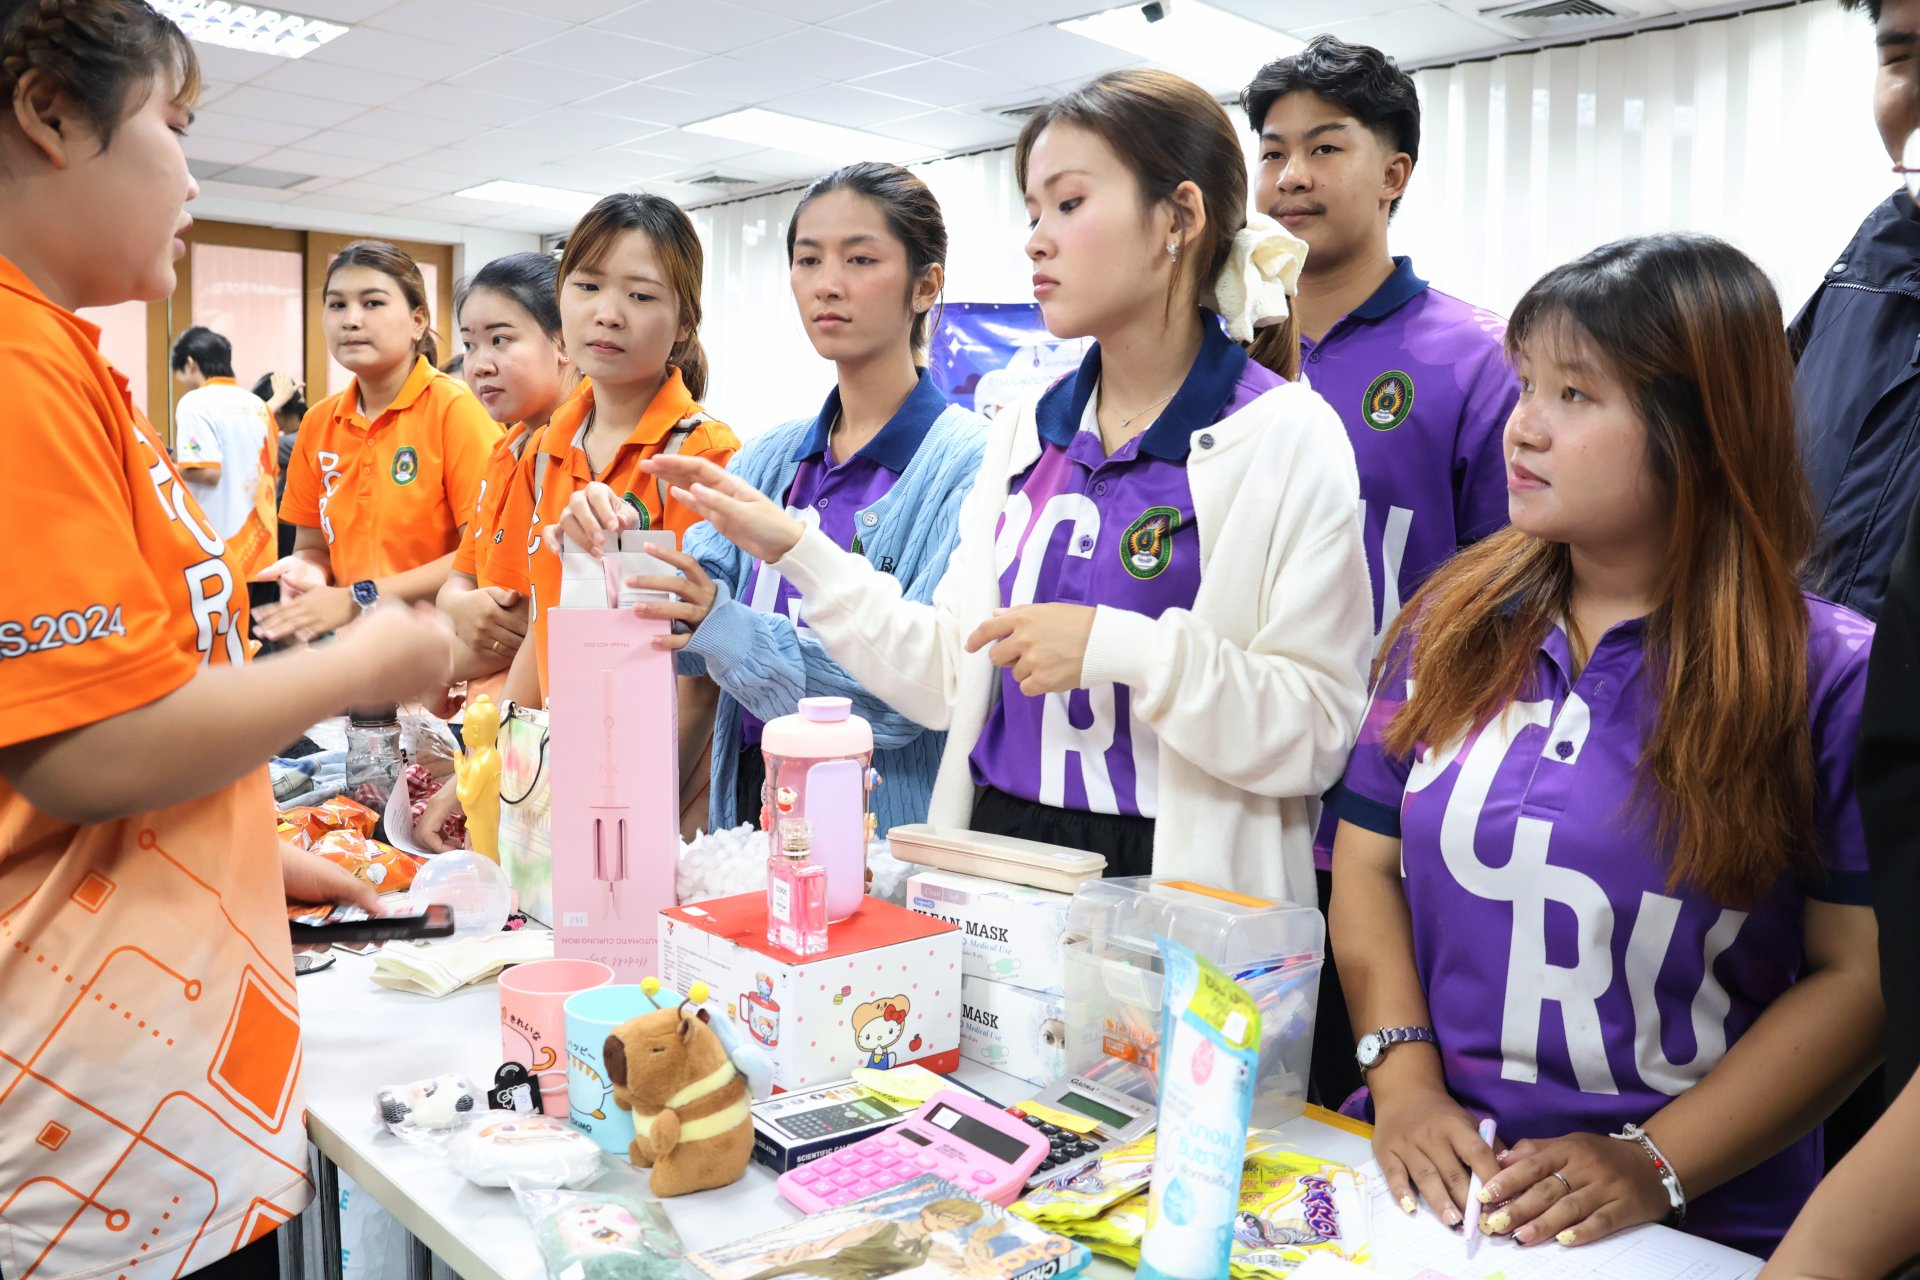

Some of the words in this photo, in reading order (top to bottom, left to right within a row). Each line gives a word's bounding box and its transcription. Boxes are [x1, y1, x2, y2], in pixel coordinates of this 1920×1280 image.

[965, 920, 1009, 943] MASK
[561, 937, 580, 945] IRON
[582, 937, 614, 945] CURLING
[970, 938, 997, 952] Medical
[962, 1003, 999, 1030] MASK
[965, 1021, 989, 1038] Medical
